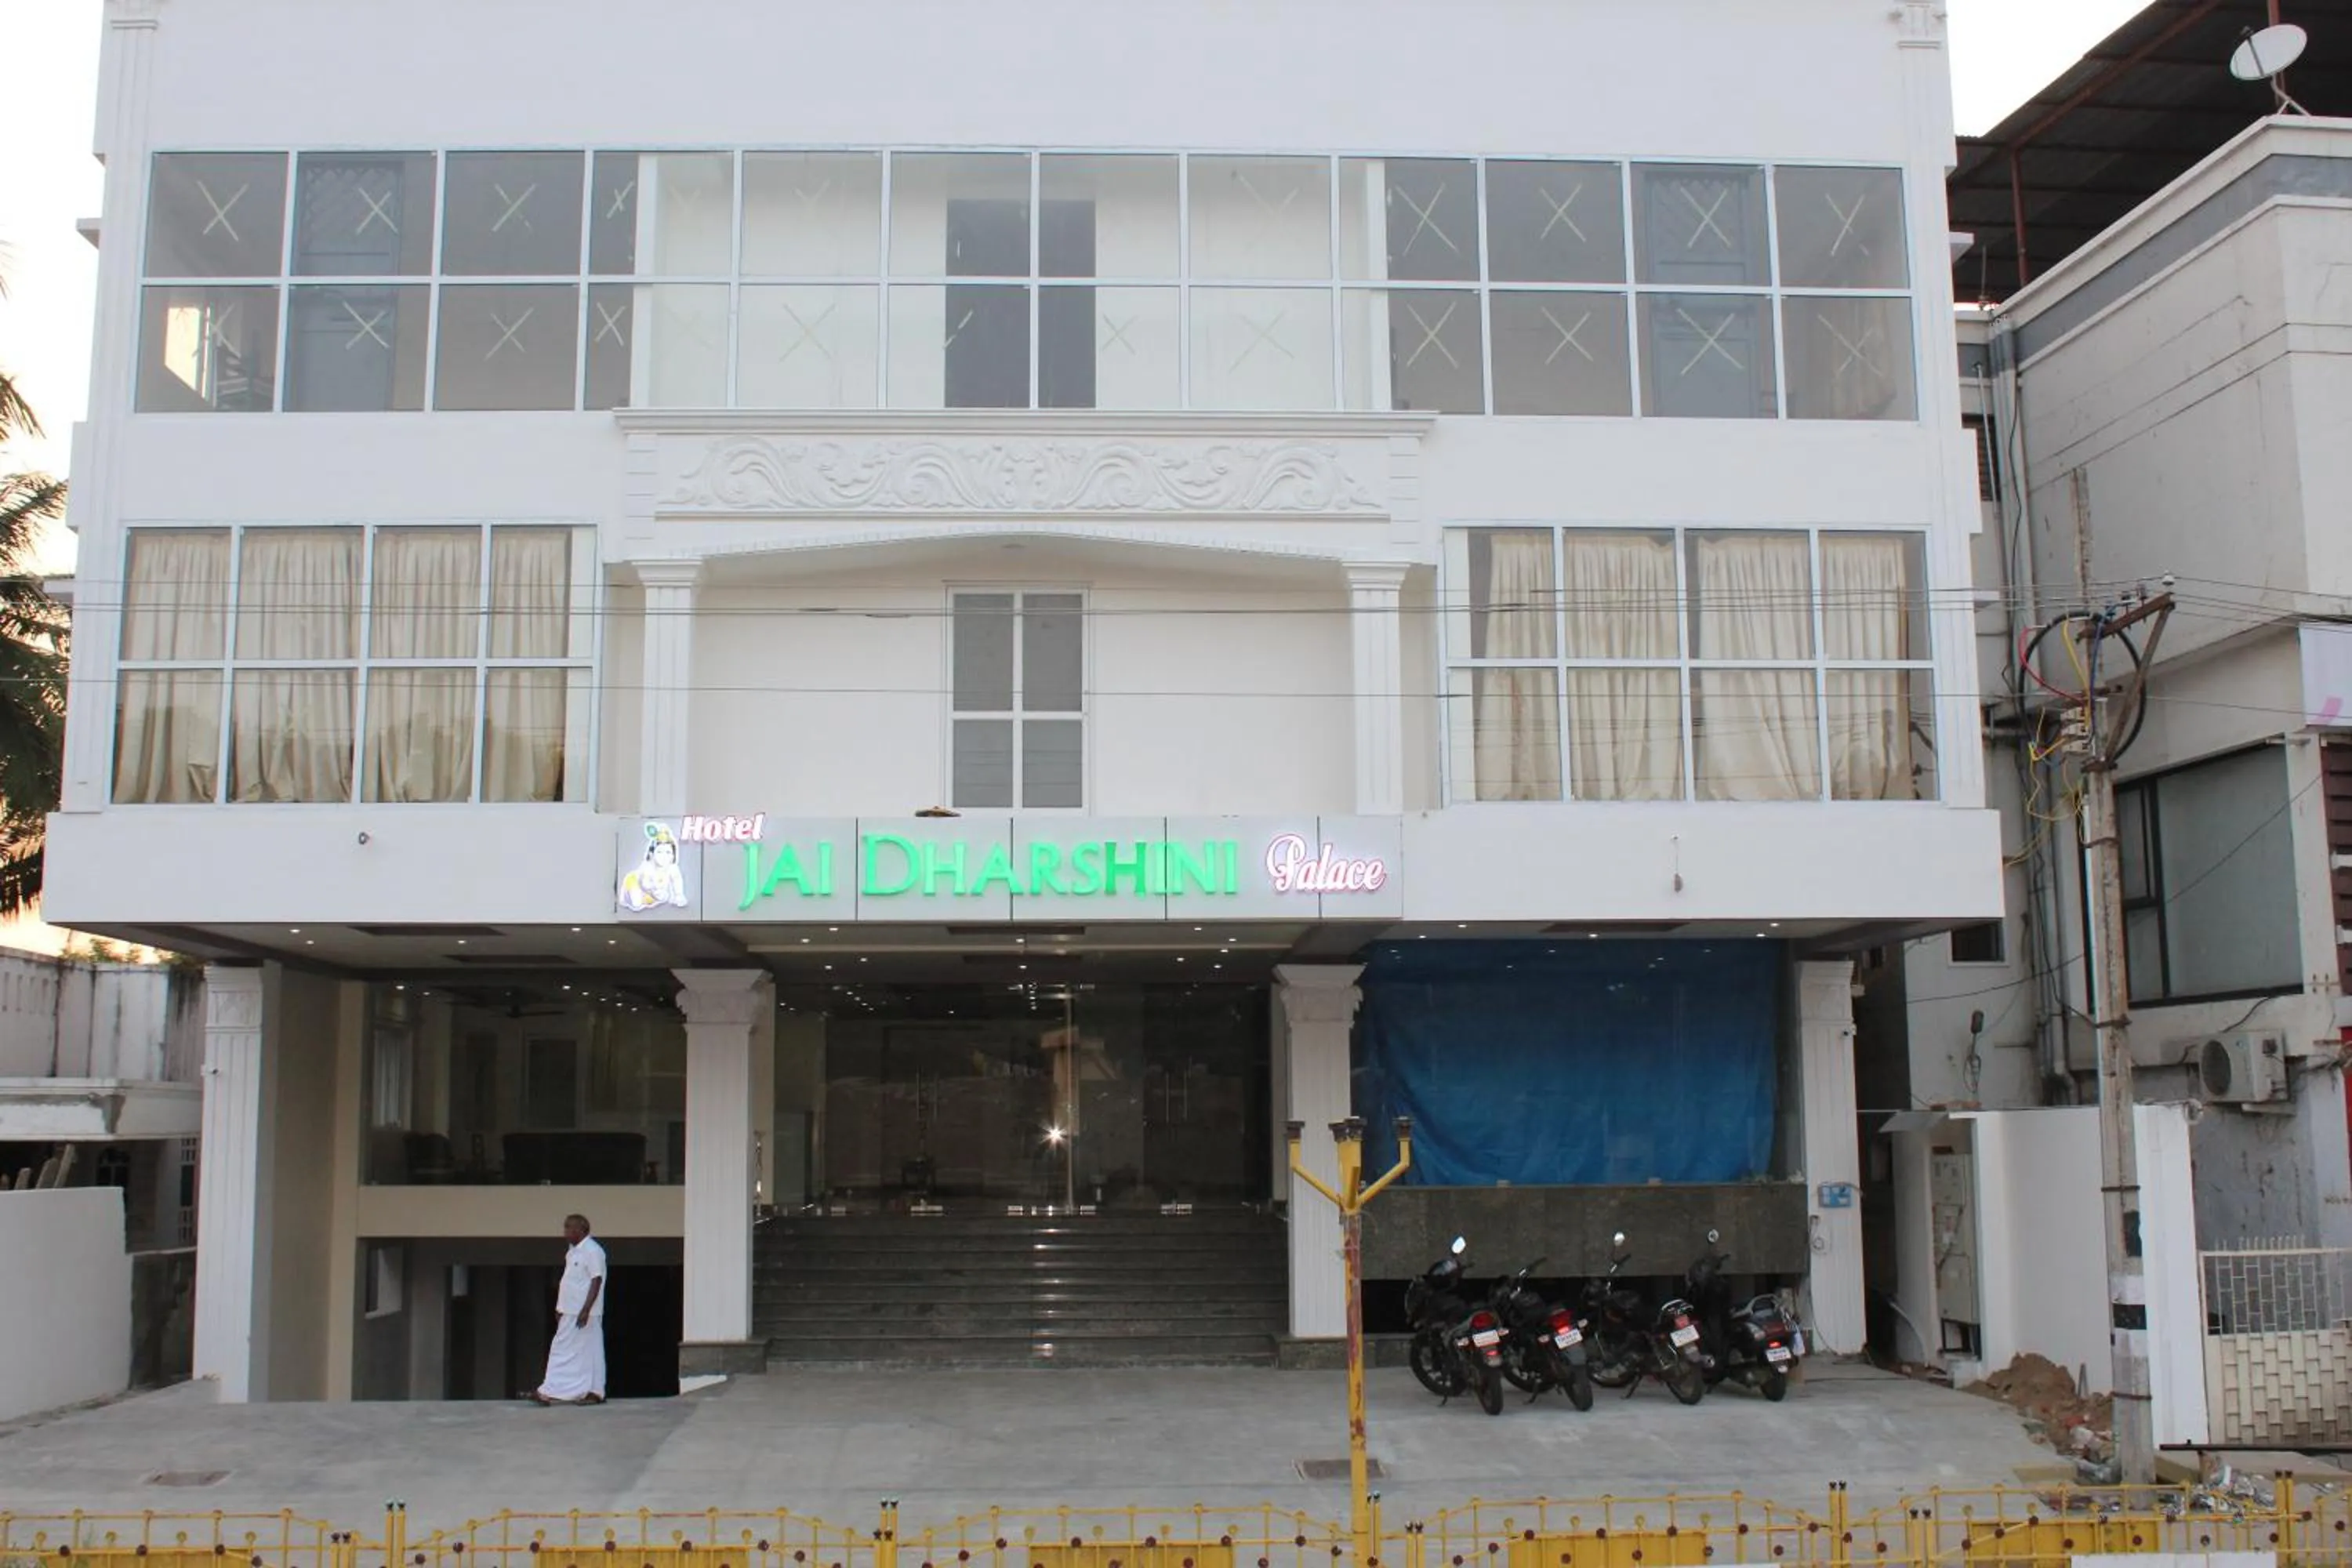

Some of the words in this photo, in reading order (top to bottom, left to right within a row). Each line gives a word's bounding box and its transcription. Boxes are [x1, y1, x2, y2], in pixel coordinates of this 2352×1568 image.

[681, 813, 765, 843] Hotel
[738, 841, 833, 911] JAI
[862, 833, 1237, 895] DHARSHINI
[1266, 833, 1386, 892] Palace
